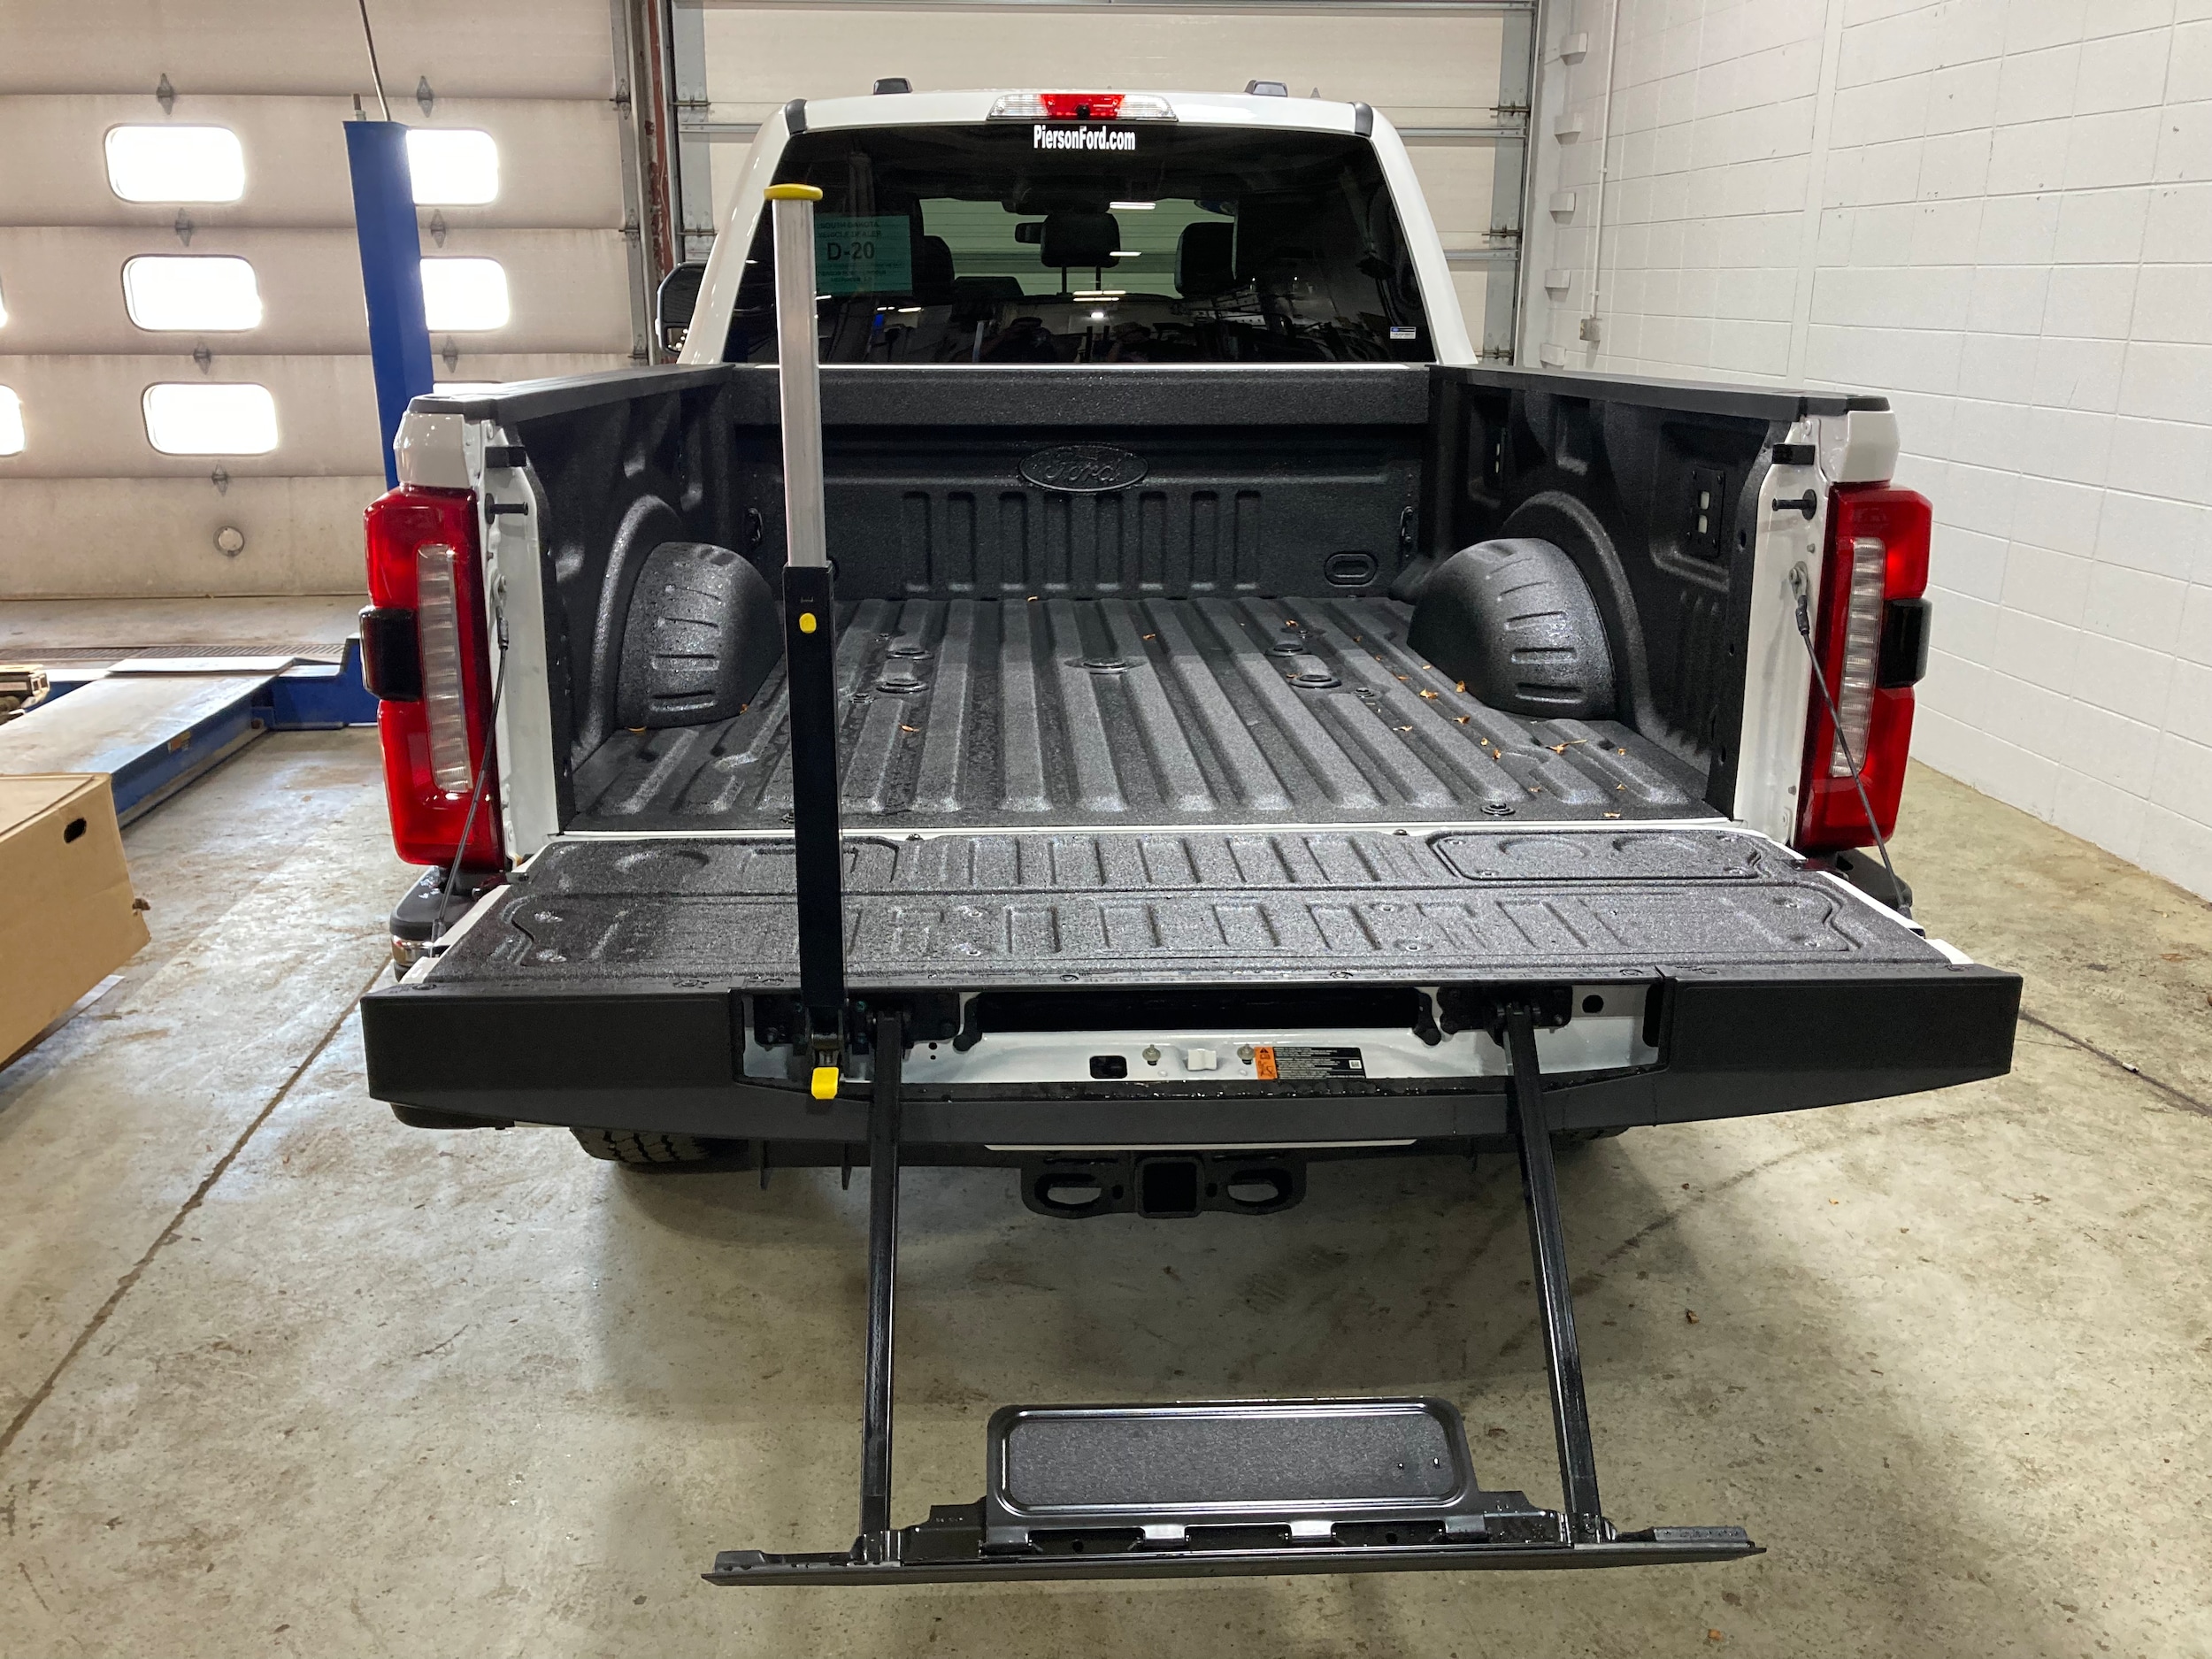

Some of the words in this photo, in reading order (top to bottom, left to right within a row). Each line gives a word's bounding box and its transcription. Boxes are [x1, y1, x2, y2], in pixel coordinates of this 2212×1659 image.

[1033, 124, 1136, 150] PiersonFord.com
[827, 242, 875, 261] D-20
[1037, 449, 1125, 482] Ford
